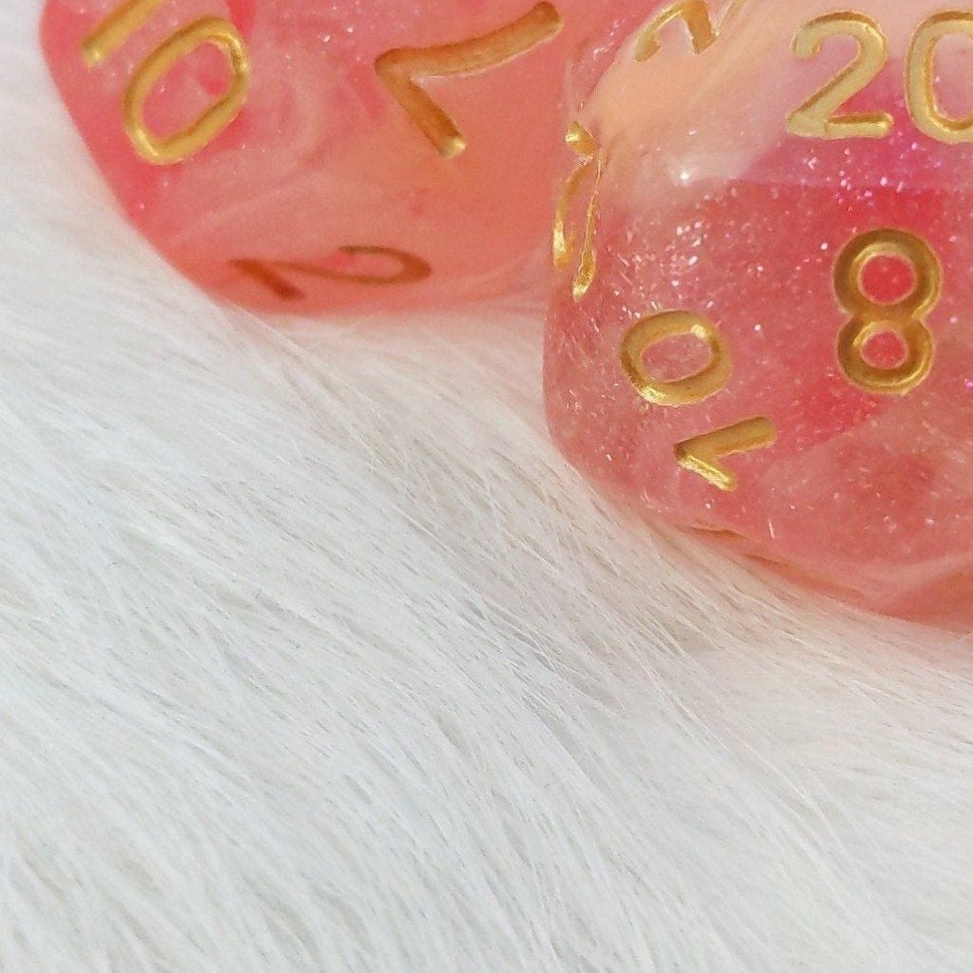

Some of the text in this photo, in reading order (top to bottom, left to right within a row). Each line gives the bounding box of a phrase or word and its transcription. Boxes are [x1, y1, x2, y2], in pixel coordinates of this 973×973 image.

[373, 0, 564, 159] 7
[831, 227, 943, 395] 8
[618, 308, 778, 492] 10
